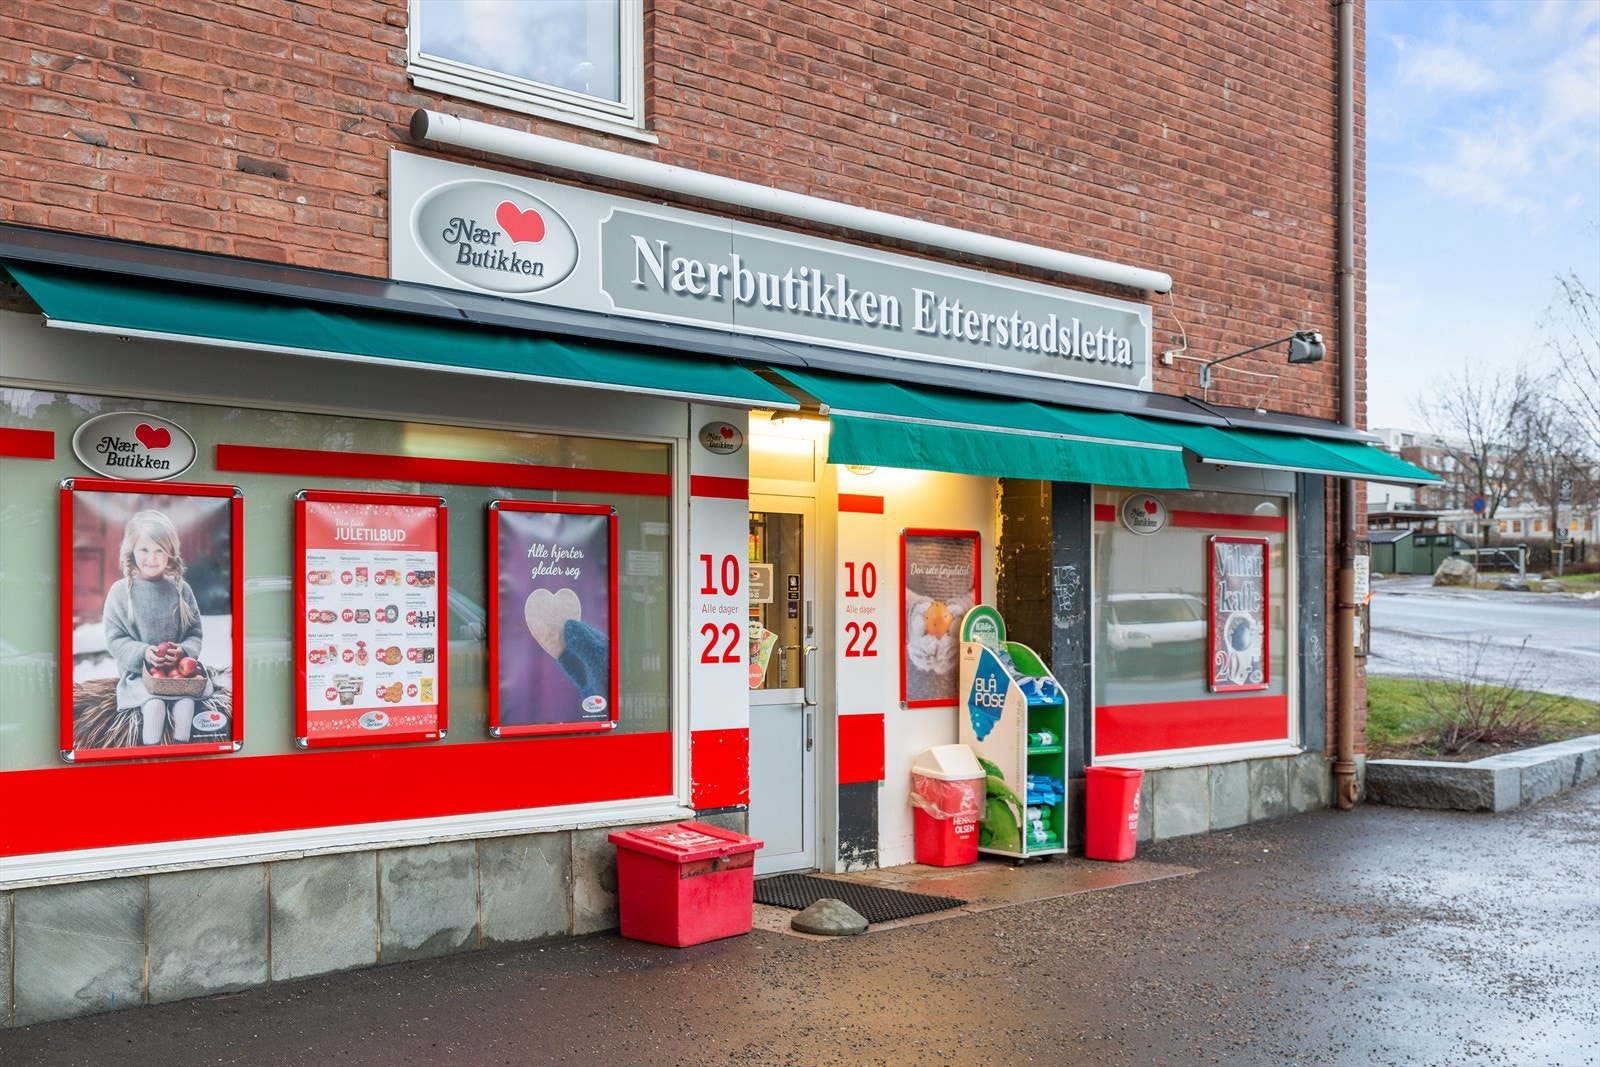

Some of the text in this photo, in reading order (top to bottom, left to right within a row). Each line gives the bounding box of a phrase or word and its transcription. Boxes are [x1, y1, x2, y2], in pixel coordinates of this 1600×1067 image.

[443, 217, 500, 246] Nær
[456, 242, 544, 278] Butikken
[630, 234, 1133, 366] Nærbutikken Etterstadsletta
[96, 436, 138, 454] Nær
[105, 451, 170, 470] Butikken
[335, 527, 406, 542] JULETILBUD
[527, 543, 585, 562] Alle hjerter
[531, 561, 582, 580] gleder seg
[700, 554, 740, 596] 10
[910, 562, 924, 576] Den
[844, 562, 877, 598] 10
[1219, 580, 1260, 613] kaffe
[702, 604, 740, 616] Alle dager
[845, 605, 876, 616] Alle dager
[700, 622, 741, 664] 22
[844, 621, 878, 658] 22
[975, 673, 997, 693] BLÅ
[975, 691, 1006, 708] POSE
[954, 824, 975, 834] OLSEN
